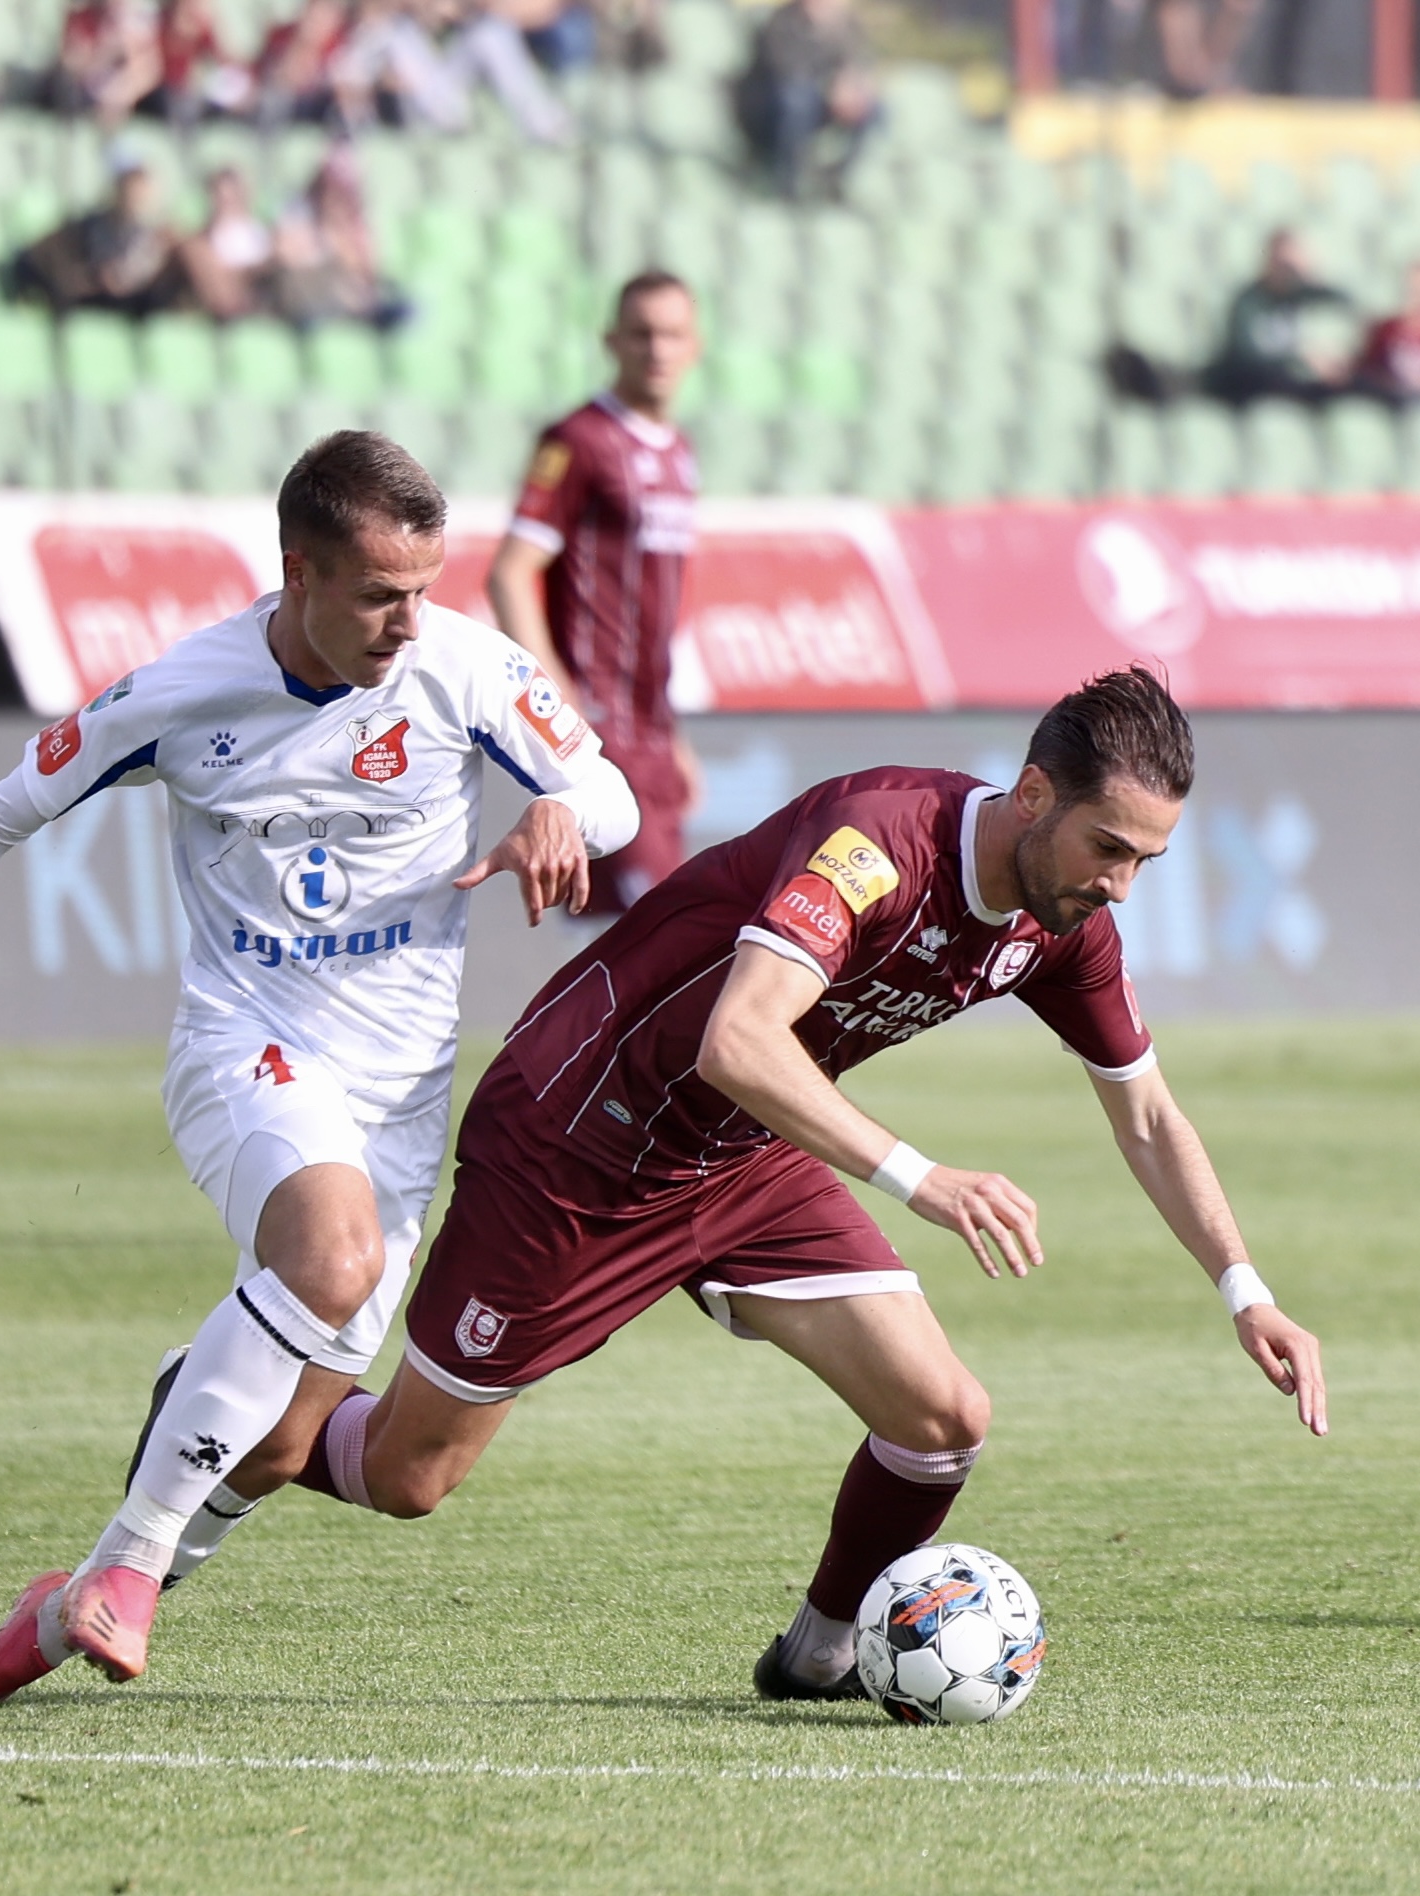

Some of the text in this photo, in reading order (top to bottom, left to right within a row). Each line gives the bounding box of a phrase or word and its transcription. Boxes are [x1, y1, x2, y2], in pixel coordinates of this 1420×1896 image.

[363, 751, 398, 762] IGMAN
[373, 742, 388, 752] FK
[202, 757, 245, 769] KELME
[361, 760, 400, 772] KONJIC
[368, 769, 392, 779] 1920
[815, 851, 869, 902] MOZZART
[782, 890, 843, 939] m:tel
[232, 919, 413, 969] igman
[254, 1043, 297, 1086] 4
[964, 1548, 1028, 1622] SELECT
